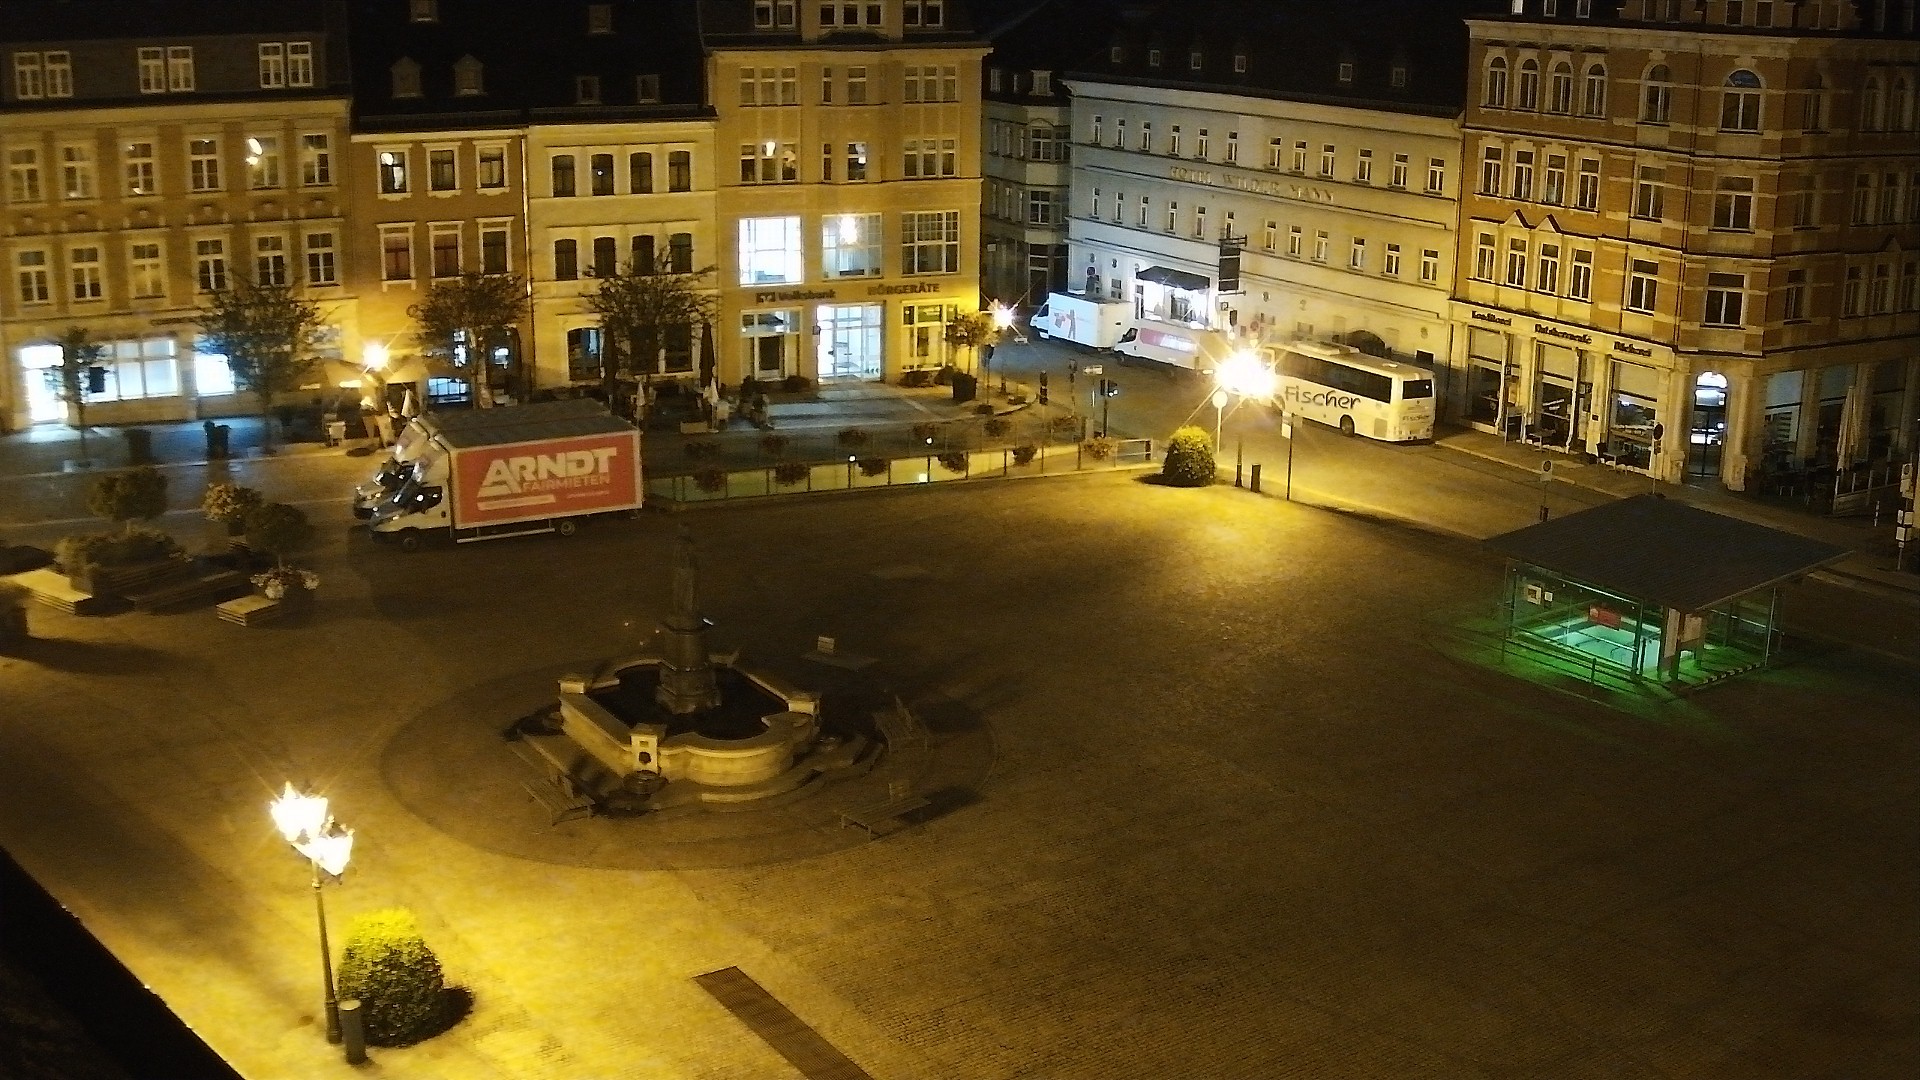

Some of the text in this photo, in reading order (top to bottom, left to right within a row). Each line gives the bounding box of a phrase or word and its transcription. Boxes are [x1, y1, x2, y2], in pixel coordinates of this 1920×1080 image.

[1170, 166, 1212, 185] HOTEL
[1285, 385, 1361, 410] Fischer
[477, 447, 617, 498] ARNDT
